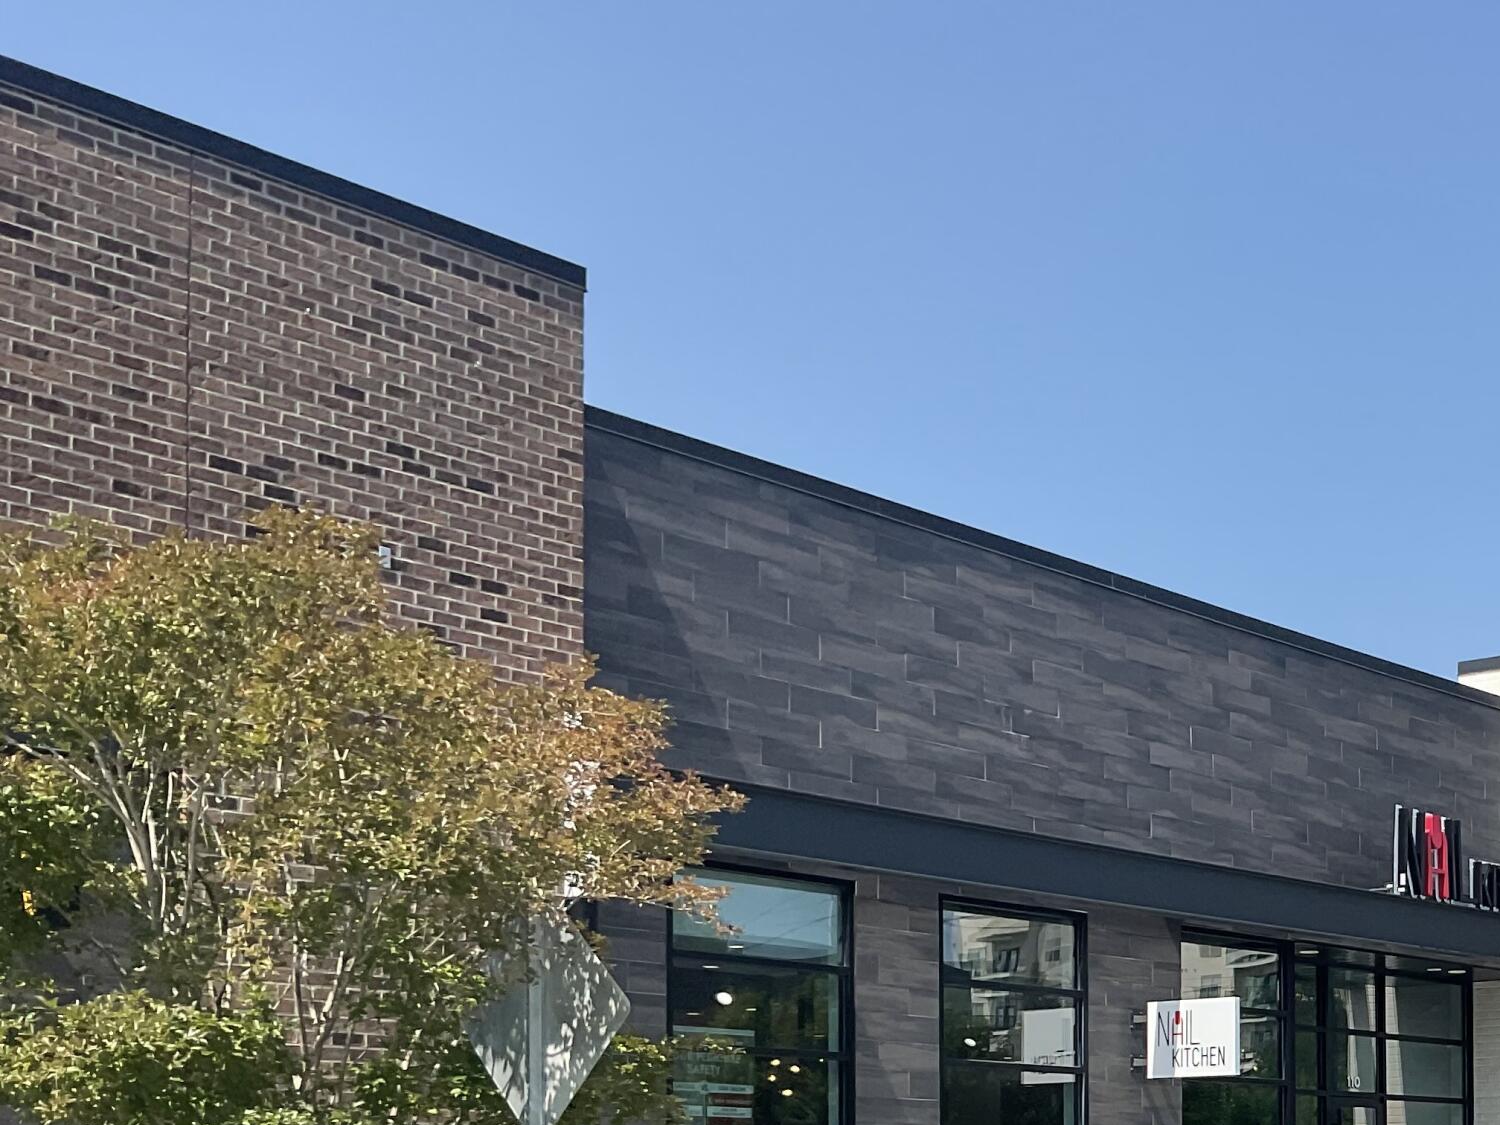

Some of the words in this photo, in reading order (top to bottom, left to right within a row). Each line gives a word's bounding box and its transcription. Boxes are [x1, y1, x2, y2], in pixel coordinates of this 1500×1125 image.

[1393, 803, 1476, 907] NAIL
[1157, 1010, 1200, 1047] NAIL
[1172, 1046, 1226, 1068] KITCHEN
[1347, 1075, 1360, 1089] 110
